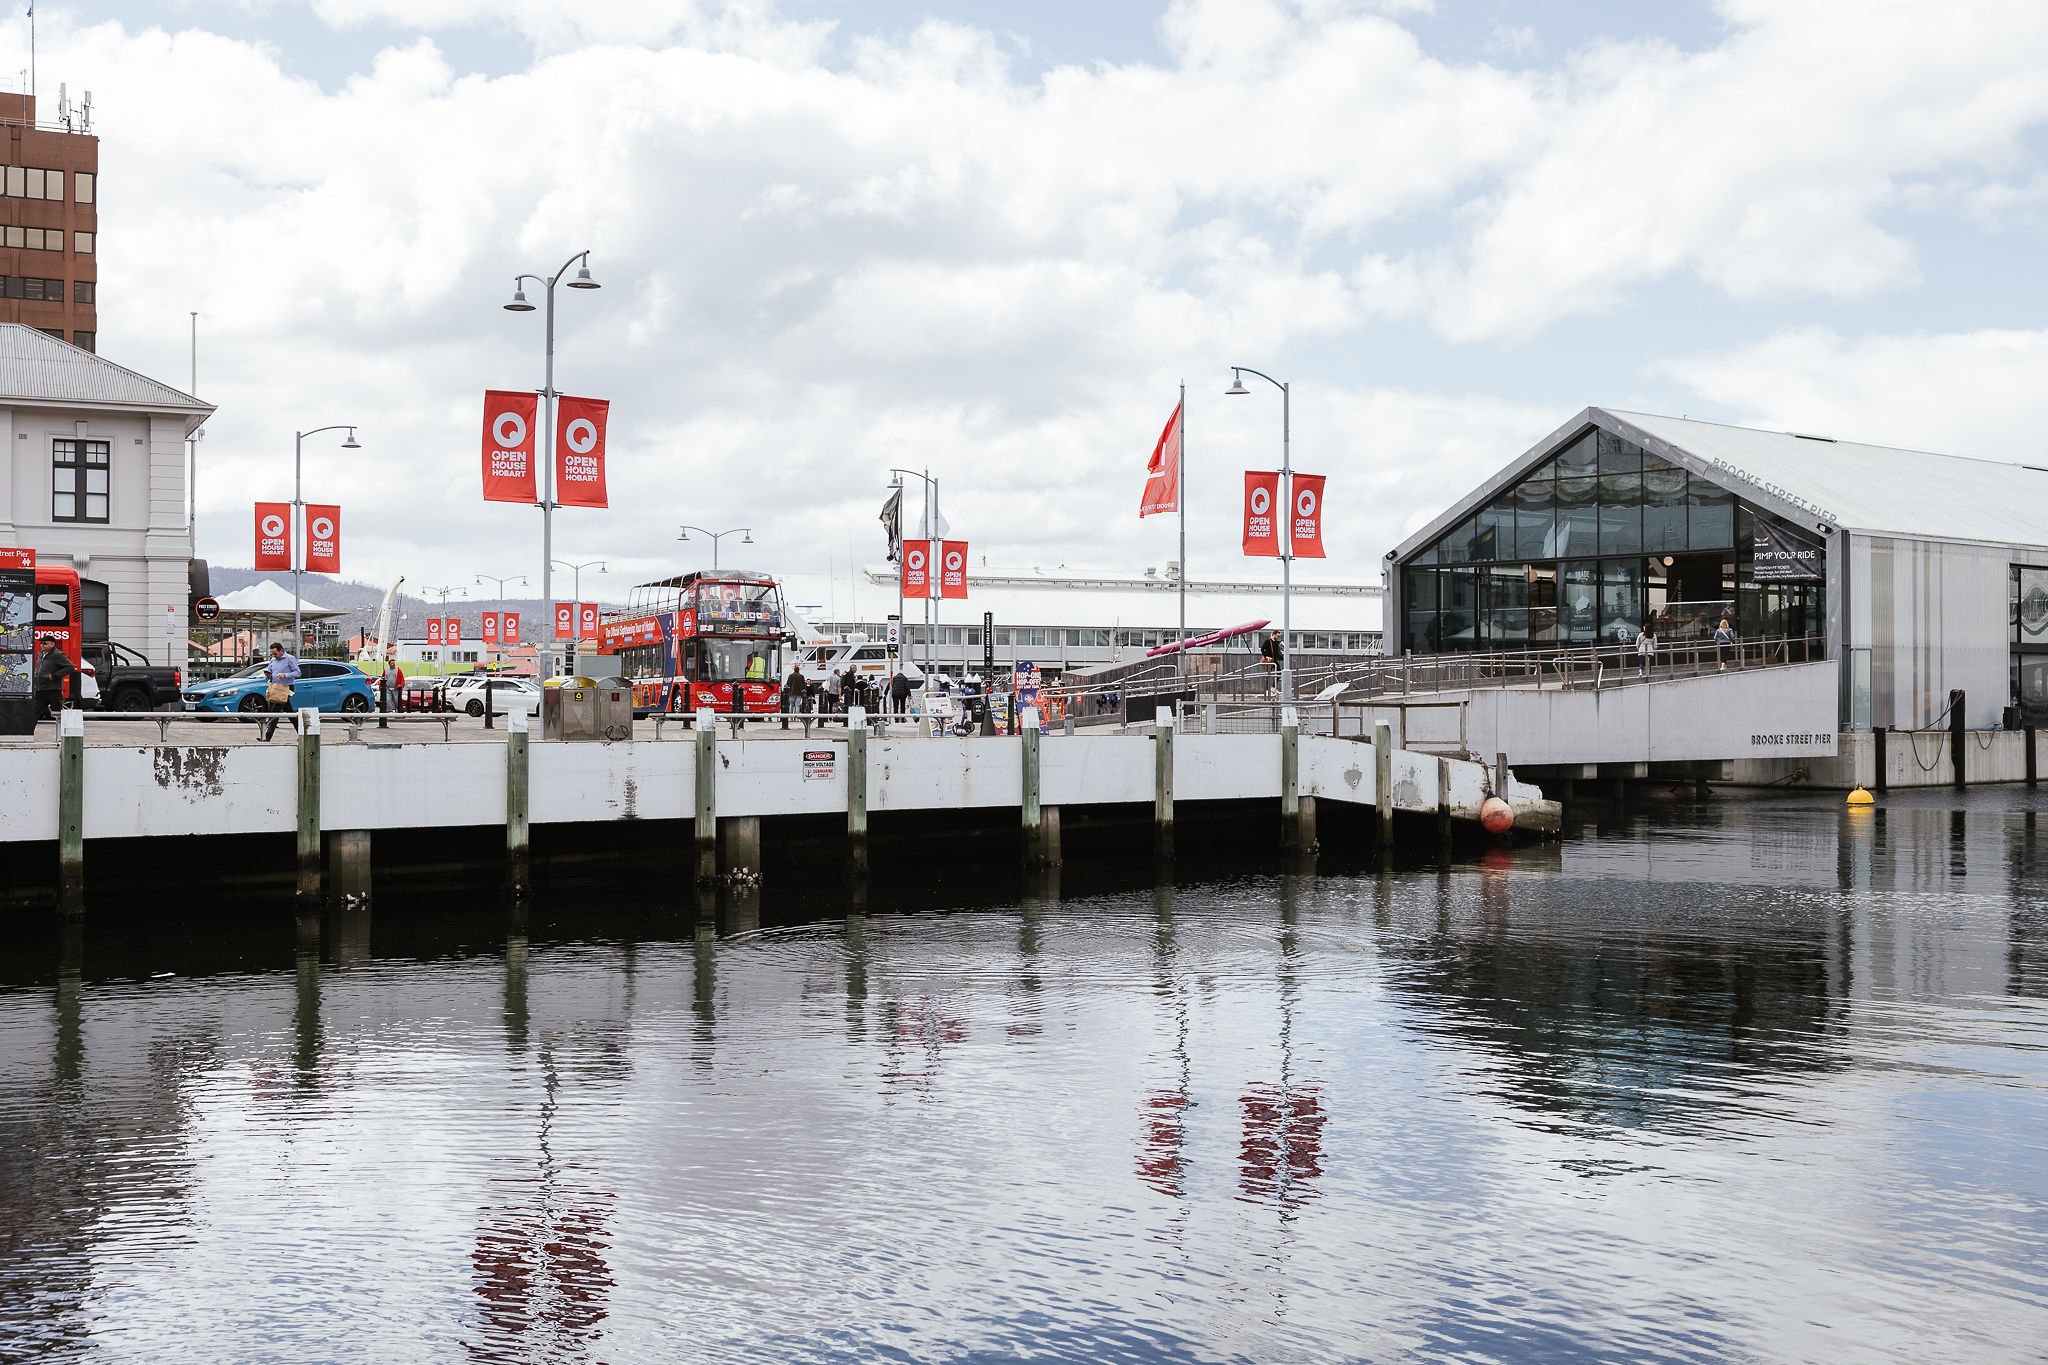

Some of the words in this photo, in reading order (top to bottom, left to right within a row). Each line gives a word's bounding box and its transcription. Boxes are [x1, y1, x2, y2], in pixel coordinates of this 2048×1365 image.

[492, 450, 526, 462] OPEN
[492, 461, 526, 470] HOUSE
[565, 456, 597, 466] OPEN
[566, 466, 598, 475] HOUSE
[1712, 457, 1762, 486] BROOKE
[1764, 482, 1808, 509] STREET
[1810, 504, 1838, 523] PIER
[1250, 517, 1270, 525] OPEN
[1296, 519, 1315, 527] OPEN
[1754, 552, 1773, 560] PIMP
[1774, 552, 1796, 560] YOUR
[1797, 551, 1815, 559] RIDE
[1751, 734, 1784, 745] BROOKE
[1786, 734, 1812, 744] STREET
[1814, 734, 1831, 744] PIER
